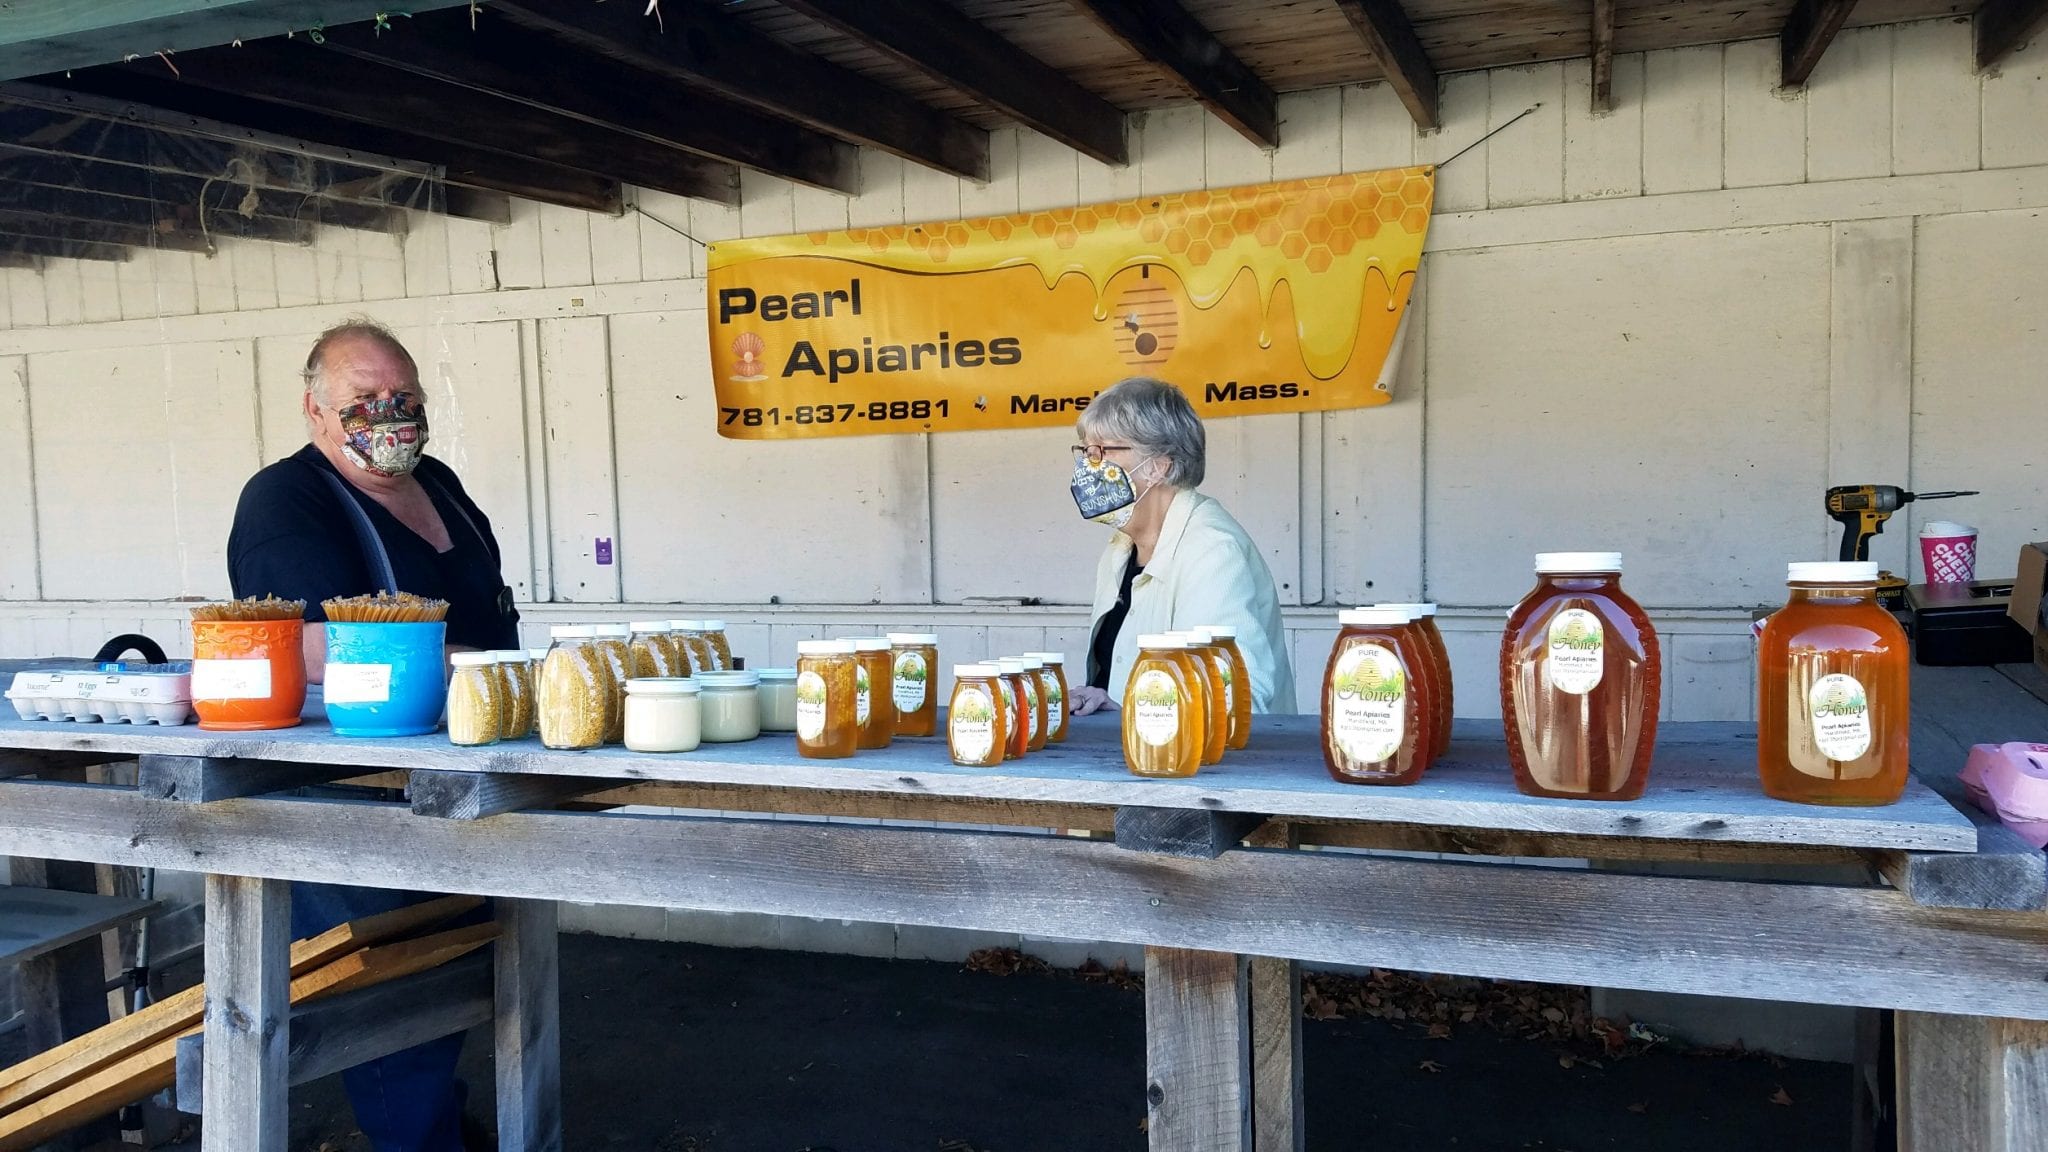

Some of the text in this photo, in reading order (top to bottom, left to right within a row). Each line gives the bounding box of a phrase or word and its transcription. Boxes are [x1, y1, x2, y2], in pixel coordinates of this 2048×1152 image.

[719, 279, 862, 324] Pearl
[781, 331, 1022, 383] Apiaries
[721, 399, 949, 427] 781-837-8881
[1205, 381, 1310, 404] Mass.
[1080, 487, 1130, 512] SUNSHINE
[1358, 649, 1380, 657] PURE
[1552, 637, 1600, 655] Honey
[1136, 695, 1177, 711] Honey
[1337, 681, 1401, 708] Honey
[1363, 710, 1391, 718] Apiaries
[1814, 702, 1866, 719] Honey
